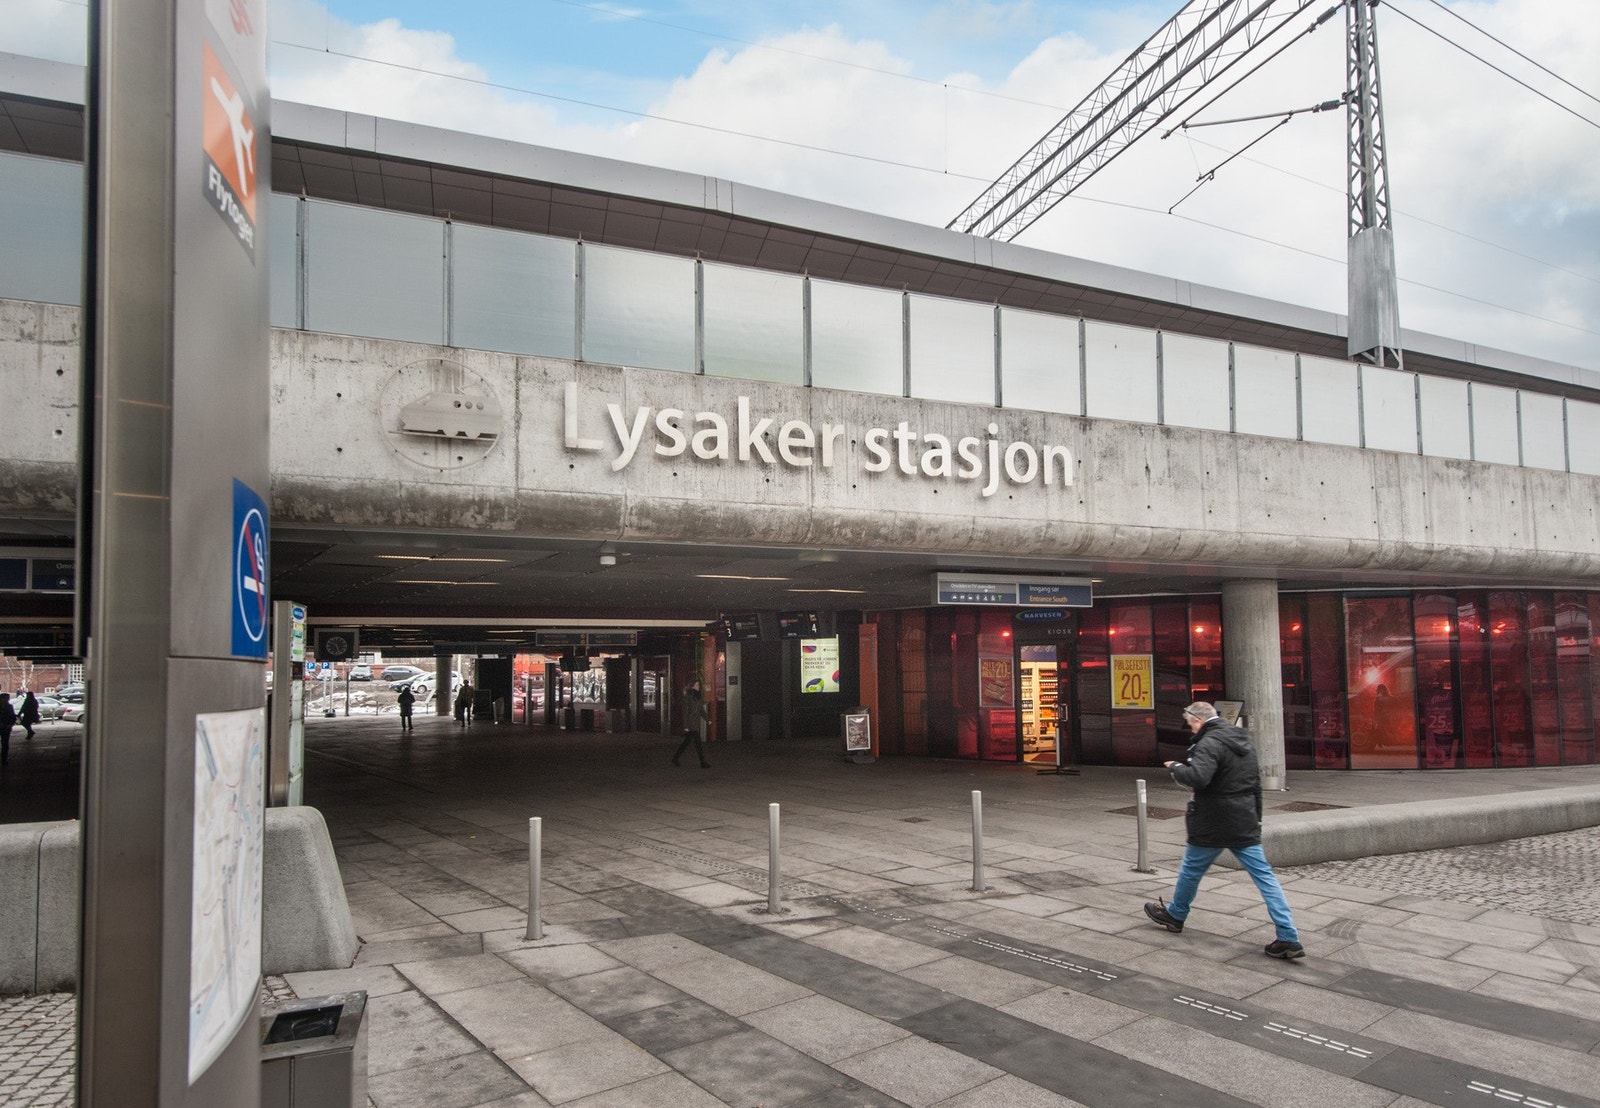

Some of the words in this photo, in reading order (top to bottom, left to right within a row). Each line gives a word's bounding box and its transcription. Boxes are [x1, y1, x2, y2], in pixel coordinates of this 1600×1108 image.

[208, 163, 254, 249] Flytoget
[564, 381, 844, 471] Lysaker
[864, 422, 1073, 497] stasjon
[1029, 585, 1051, 593] Inngang
[1029, 595, 1052, 603] Entrance
[1052, 595, 1069, 603] South
[726, 628, 732, 638] 3
[811, 623, 817, 633] 4
[1121, 673, 1149, 702] 20,-
[1428, 715, 1452, 731] 25,-
